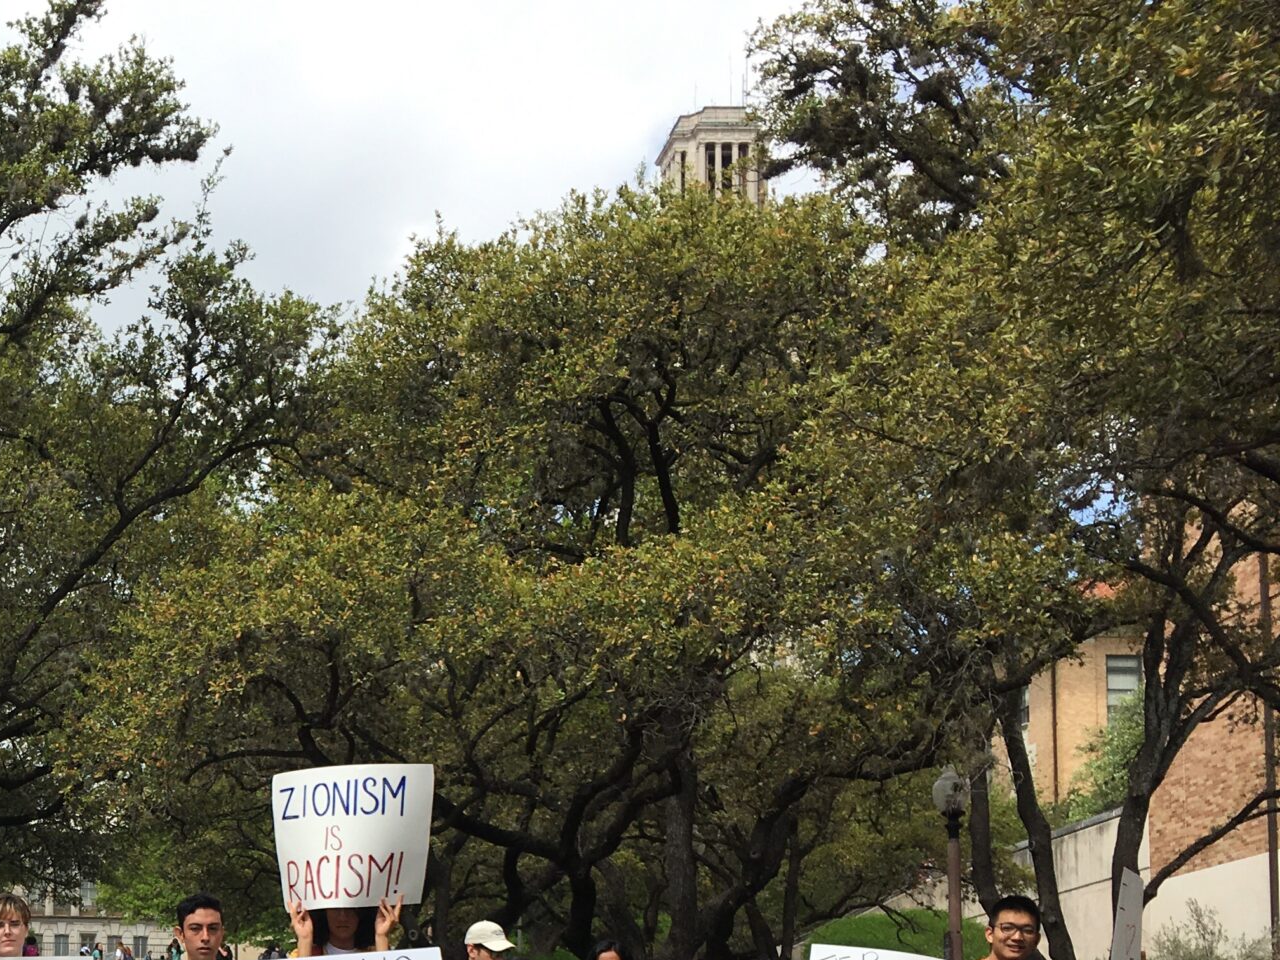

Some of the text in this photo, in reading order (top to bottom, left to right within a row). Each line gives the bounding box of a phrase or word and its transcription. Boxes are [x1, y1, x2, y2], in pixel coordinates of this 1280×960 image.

[279, 775, 407, 821] ZIONISM
[325, 824, 343, 851] IS
[287, 851, 404, 902] RACISM!
